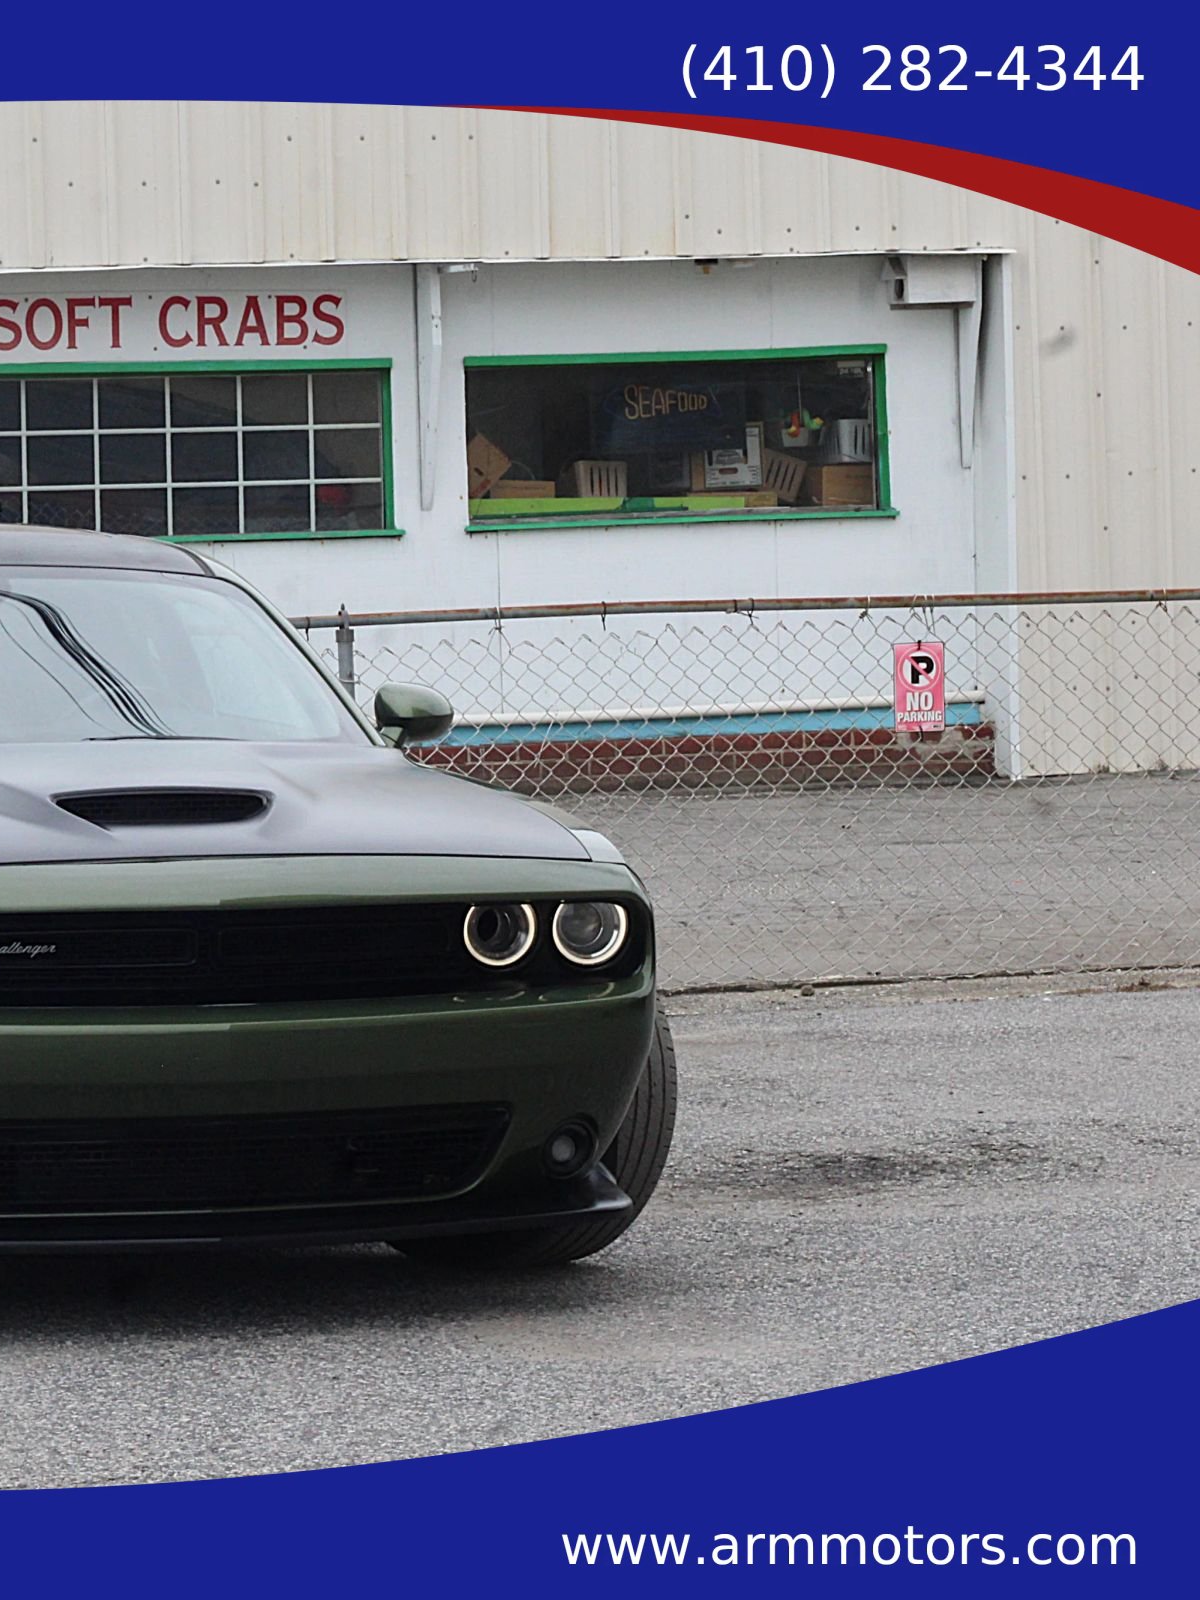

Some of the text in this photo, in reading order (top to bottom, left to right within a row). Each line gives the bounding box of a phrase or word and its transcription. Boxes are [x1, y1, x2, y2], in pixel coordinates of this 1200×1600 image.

[158, 293, 345, 348] CRABS
[623, 384, 708, 420] SEAFOOD
[905, 691, 934, 712] NO
[896, 710, 942, 723] PARKING
